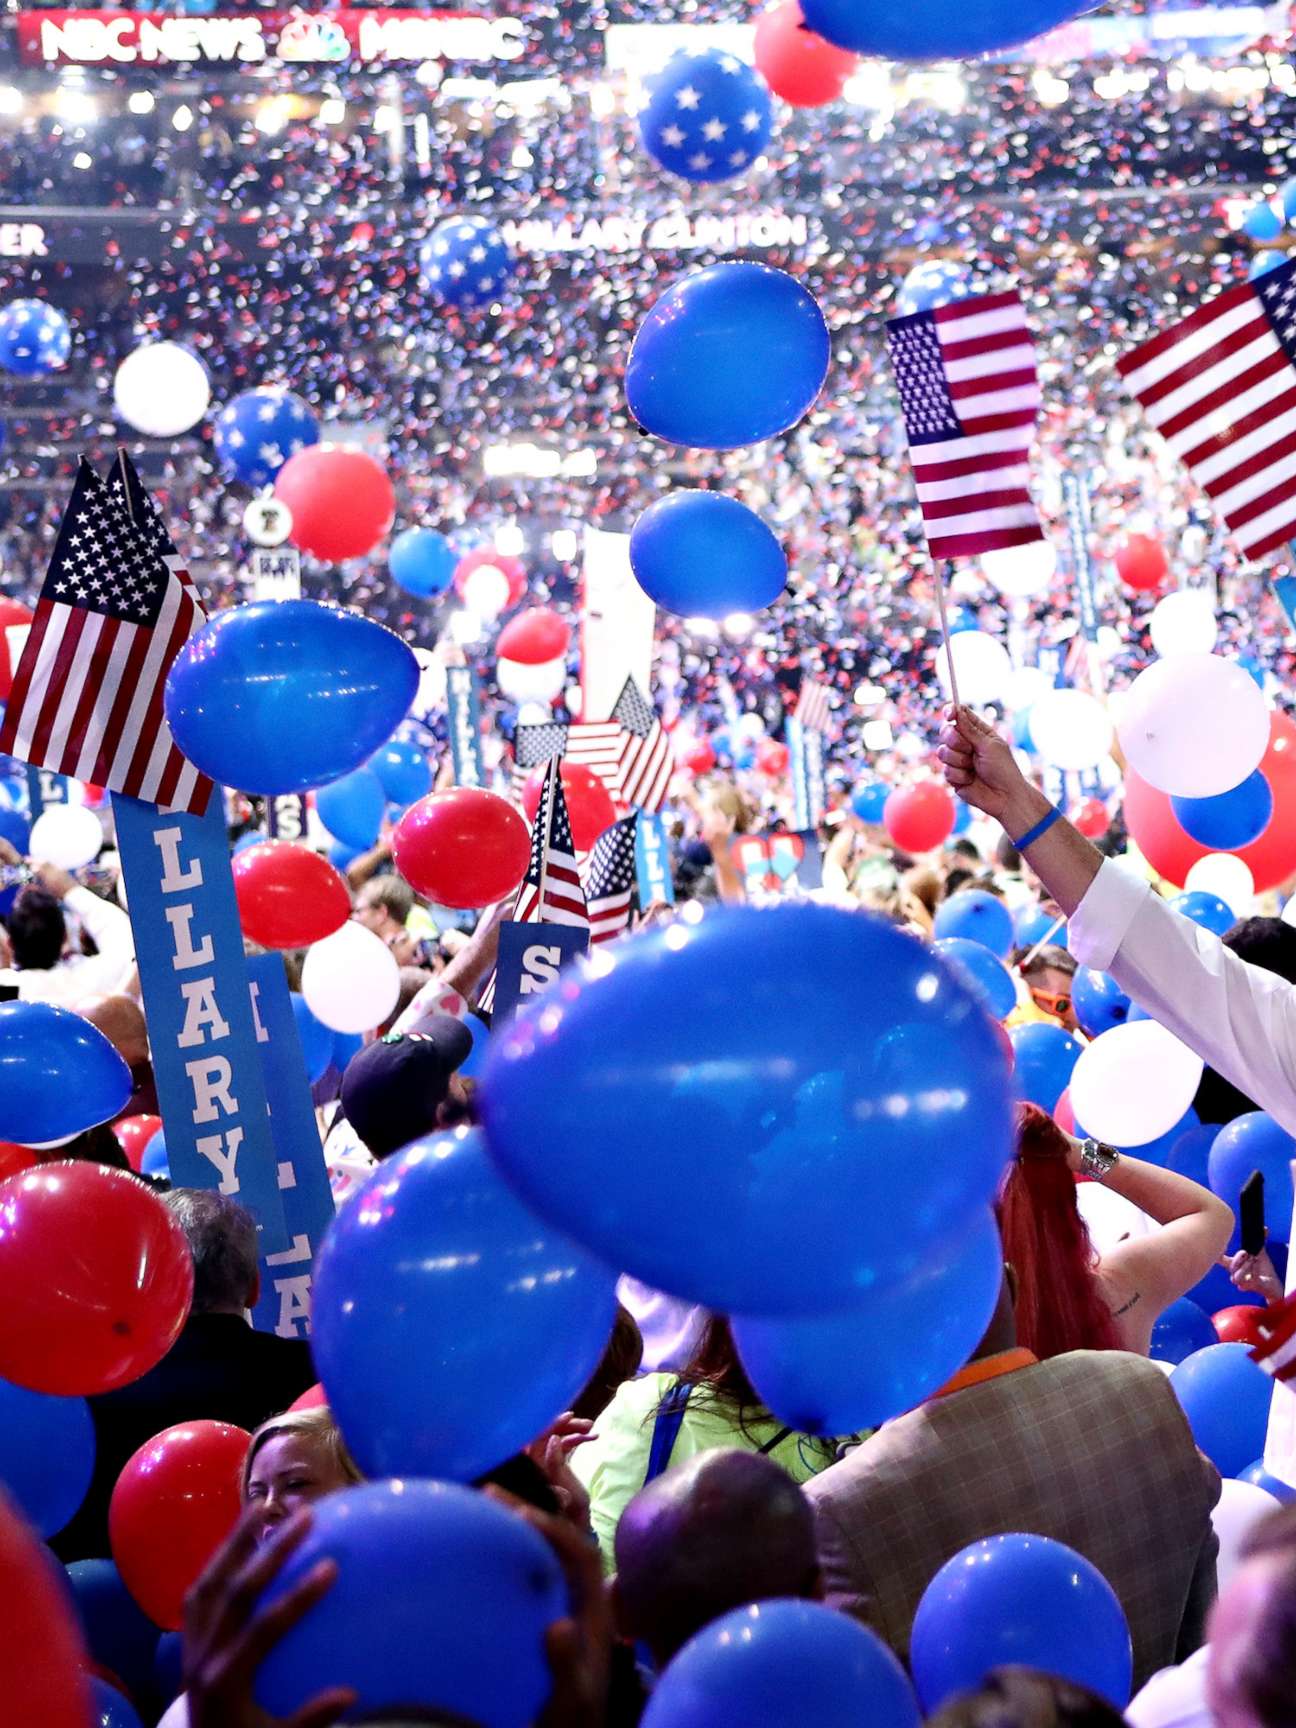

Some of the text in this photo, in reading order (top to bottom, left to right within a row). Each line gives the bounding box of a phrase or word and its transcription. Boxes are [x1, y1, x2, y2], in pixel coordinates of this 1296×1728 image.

[40, 16, 266, 61] NBC NEWS
[153, 803, 243, 1196] LLARY
